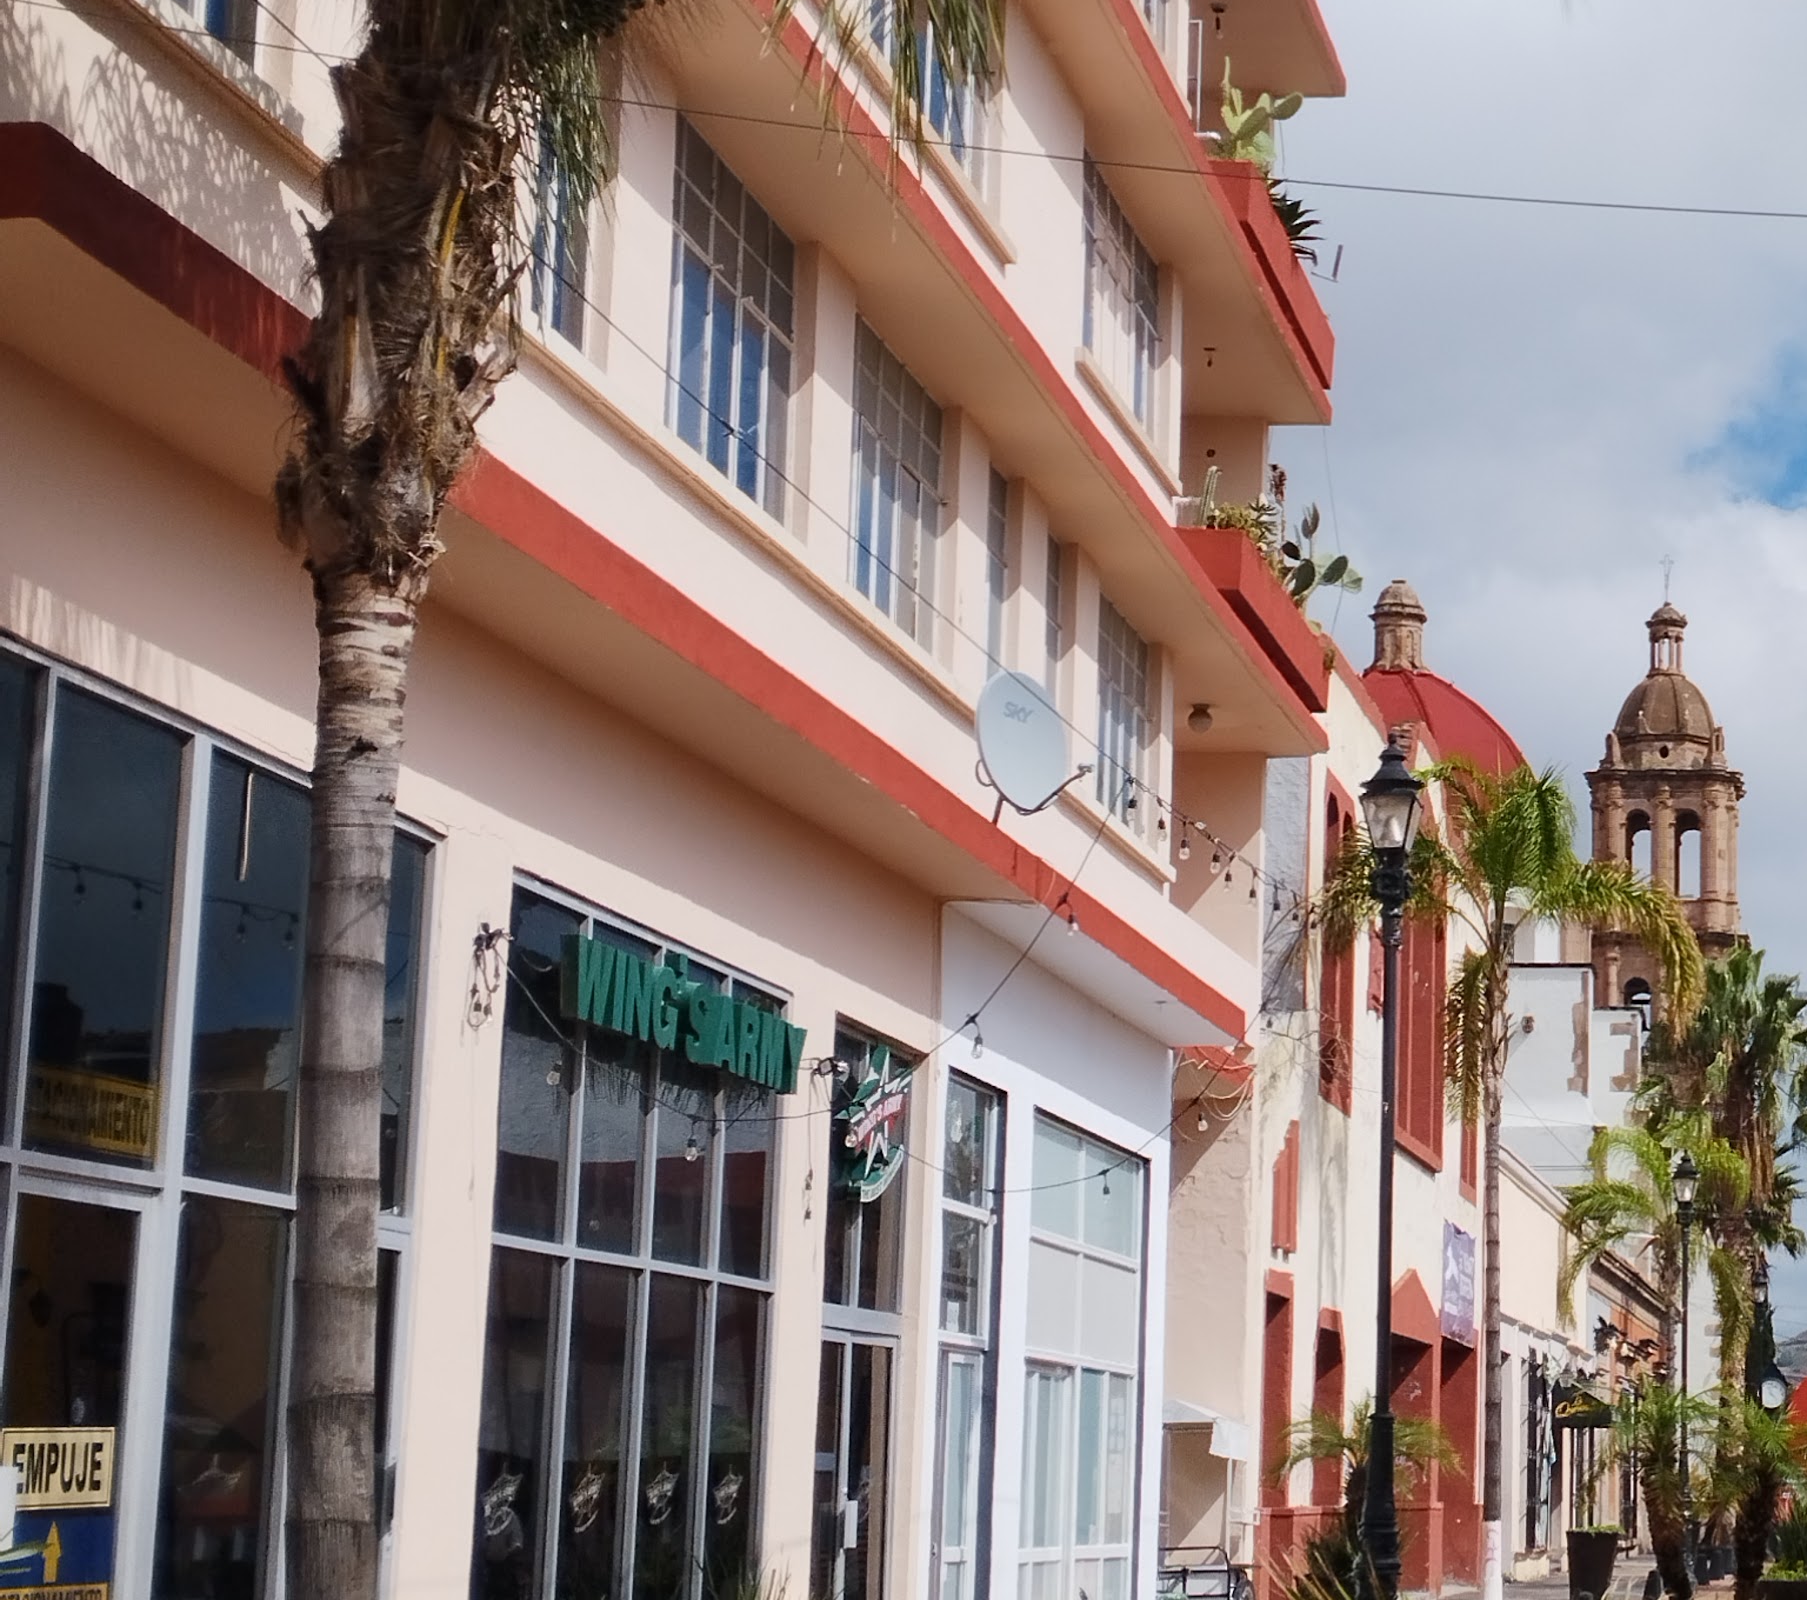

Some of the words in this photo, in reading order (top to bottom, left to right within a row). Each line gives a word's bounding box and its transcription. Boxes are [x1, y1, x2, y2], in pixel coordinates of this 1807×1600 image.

[1003, 701, 1034, 723] SKY
[576, 937, 712, 1066] WING'S
[715, 996, 808, 1095] ARMY
[12, 1441, 104, 1495] EMPUJE
